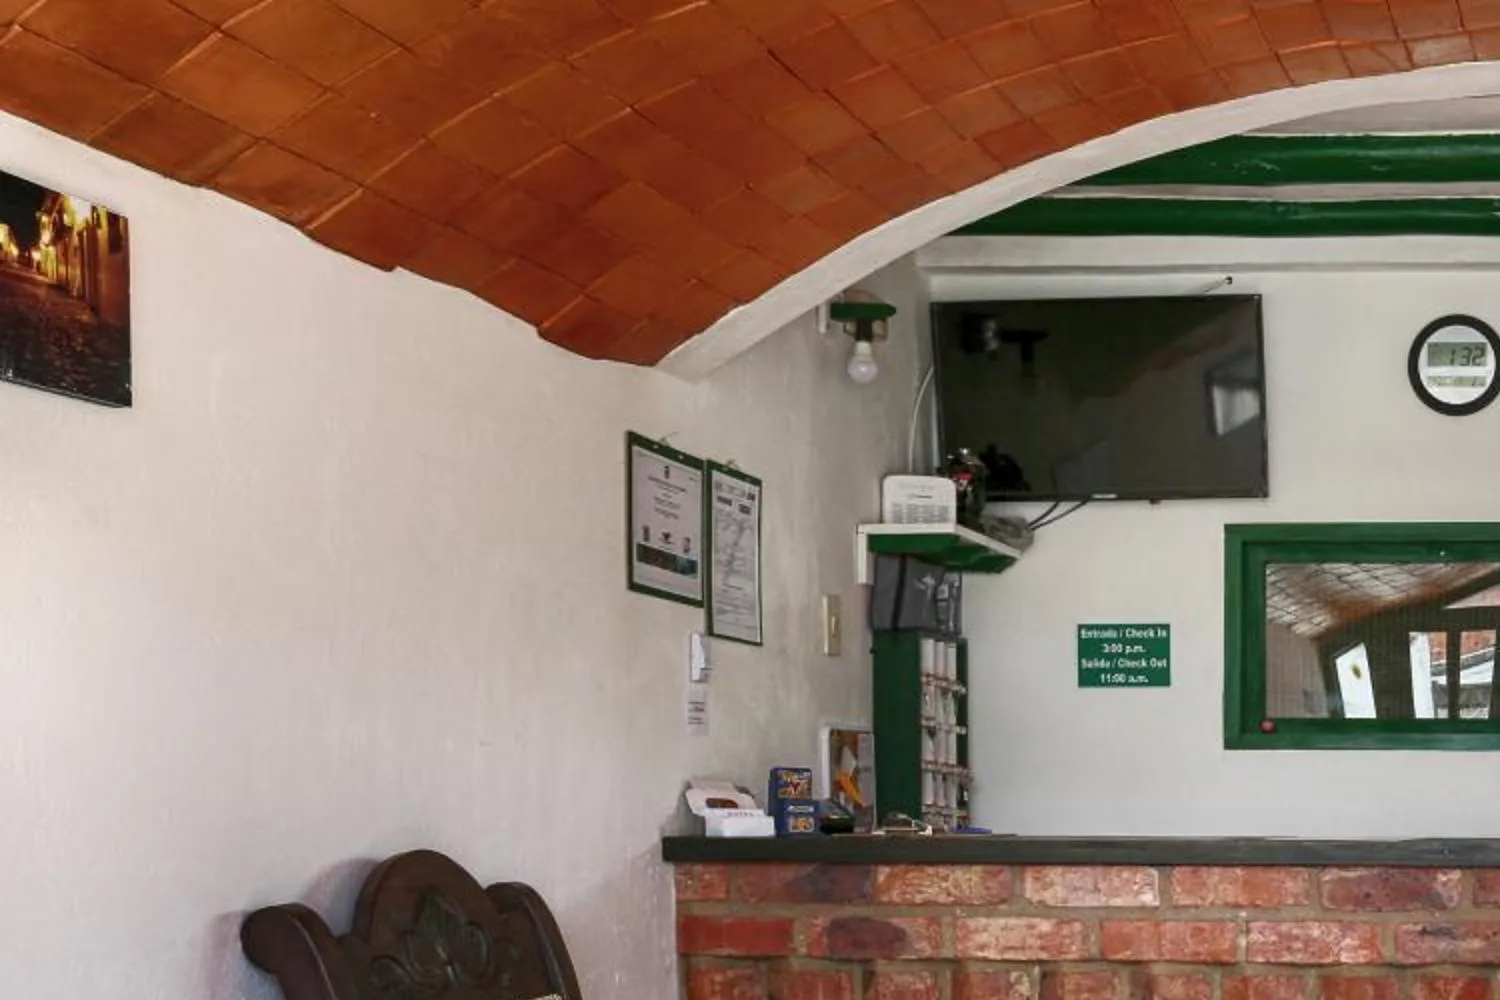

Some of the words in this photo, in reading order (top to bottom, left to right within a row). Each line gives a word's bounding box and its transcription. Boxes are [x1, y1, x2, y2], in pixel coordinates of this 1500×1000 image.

[1125, 627, 1155, 639] Check
[1157, 627, 1167, 638] In
[1081, 658, 1111, 668] Salida
[1117, 658, 1147, 668] Check
[1149, 657, 1167, 668] Out
[1101, 673, 1127, 683] 11:00
